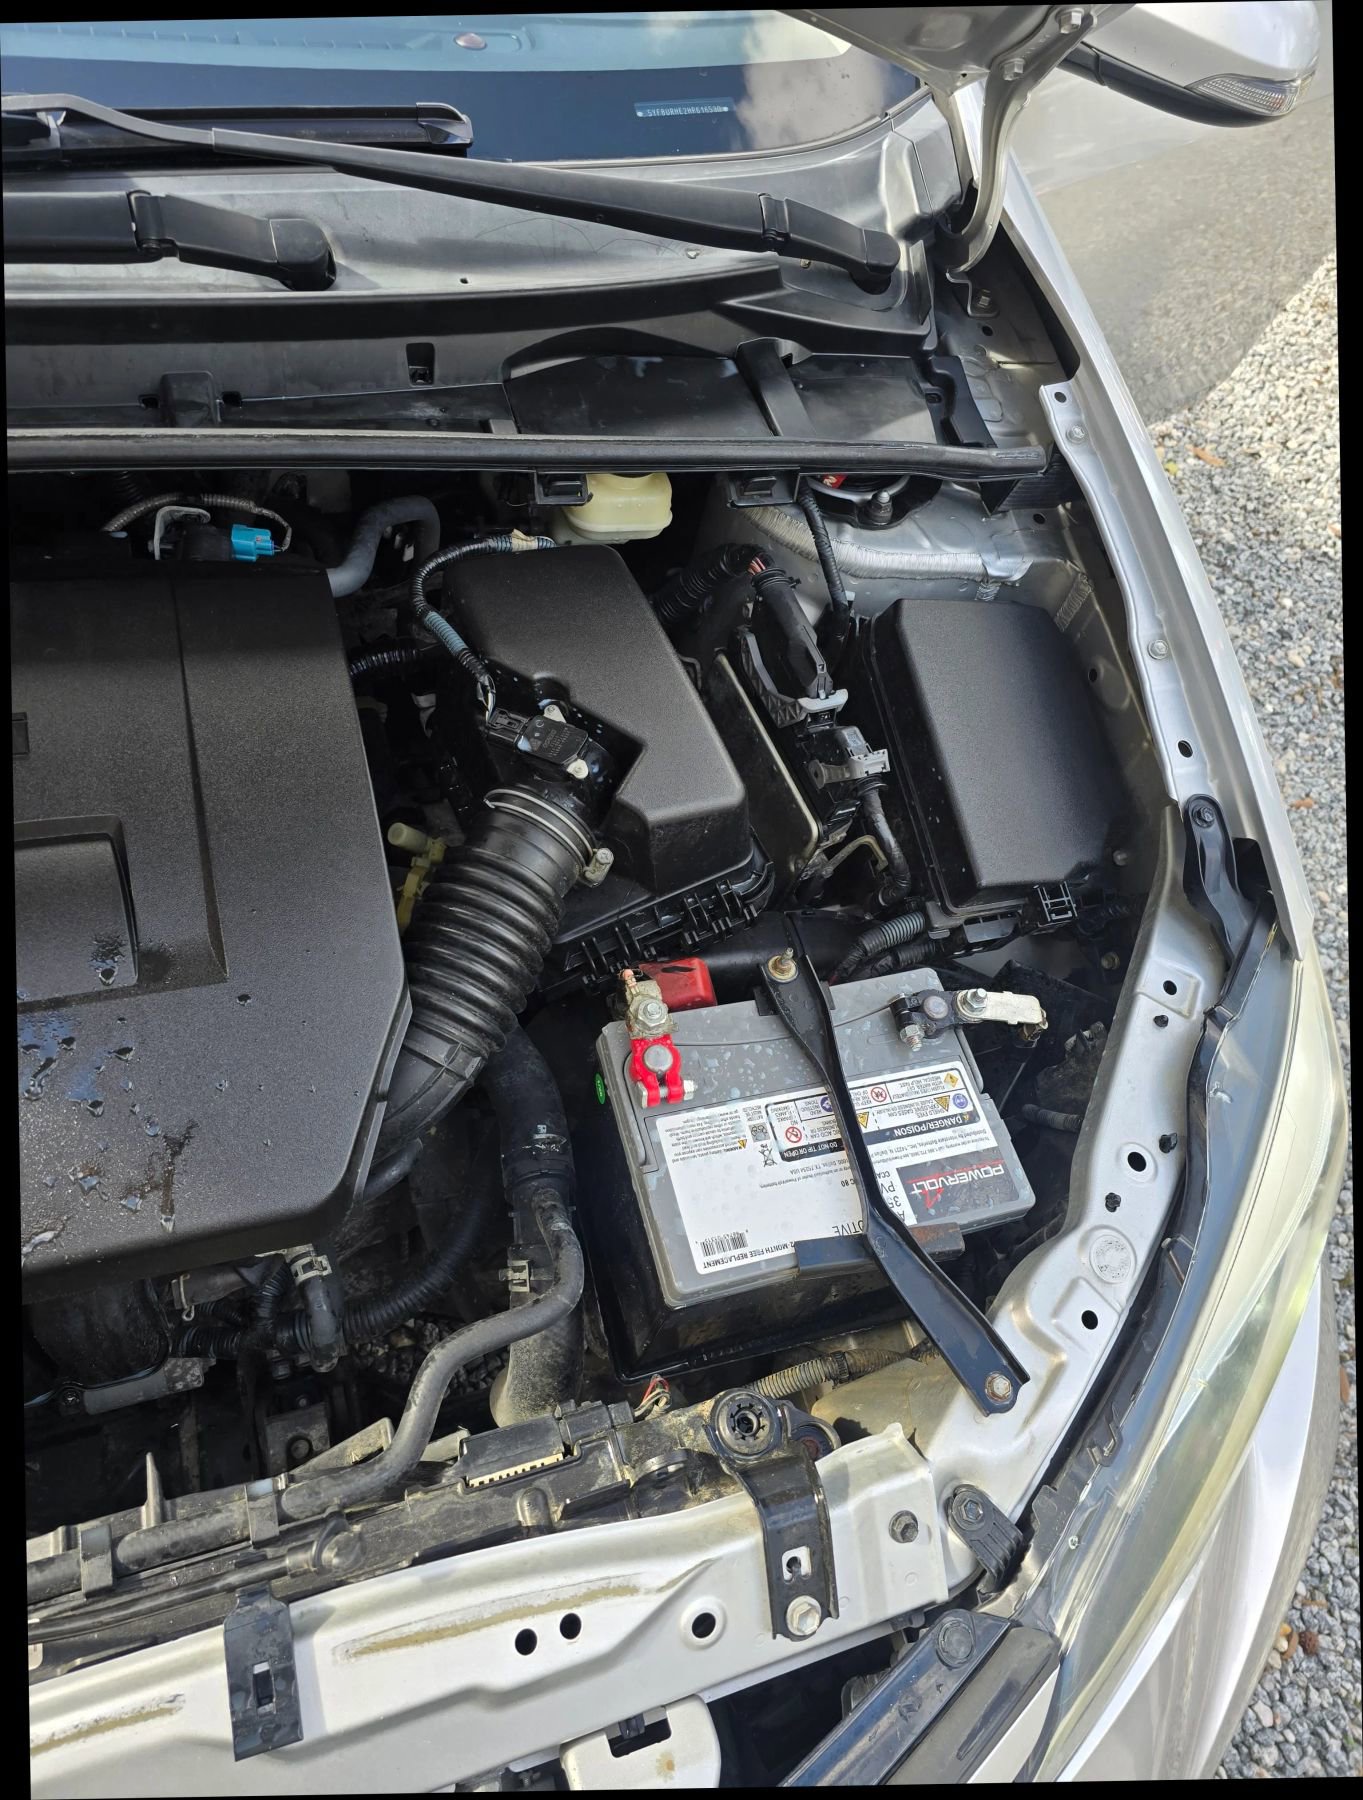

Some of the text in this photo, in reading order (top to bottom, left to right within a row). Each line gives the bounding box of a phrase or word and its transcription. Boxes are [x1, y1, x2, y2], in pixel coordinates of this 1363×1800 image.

[892, 1115, 963, 1136] DANGER/POISON
[806, 1145, 817, 1153] TIP
[815, 1142, 829, 1151] NOT
[782, 1148, 799, 1157] OPEN
[839, 1179, 849, 1187] 80
[907, 1163, 1005, 1194] POWERVOLT
[749, 1247, 765, 1257] FREE
[701, 1251, 748, 1269] REPLACEMENT
